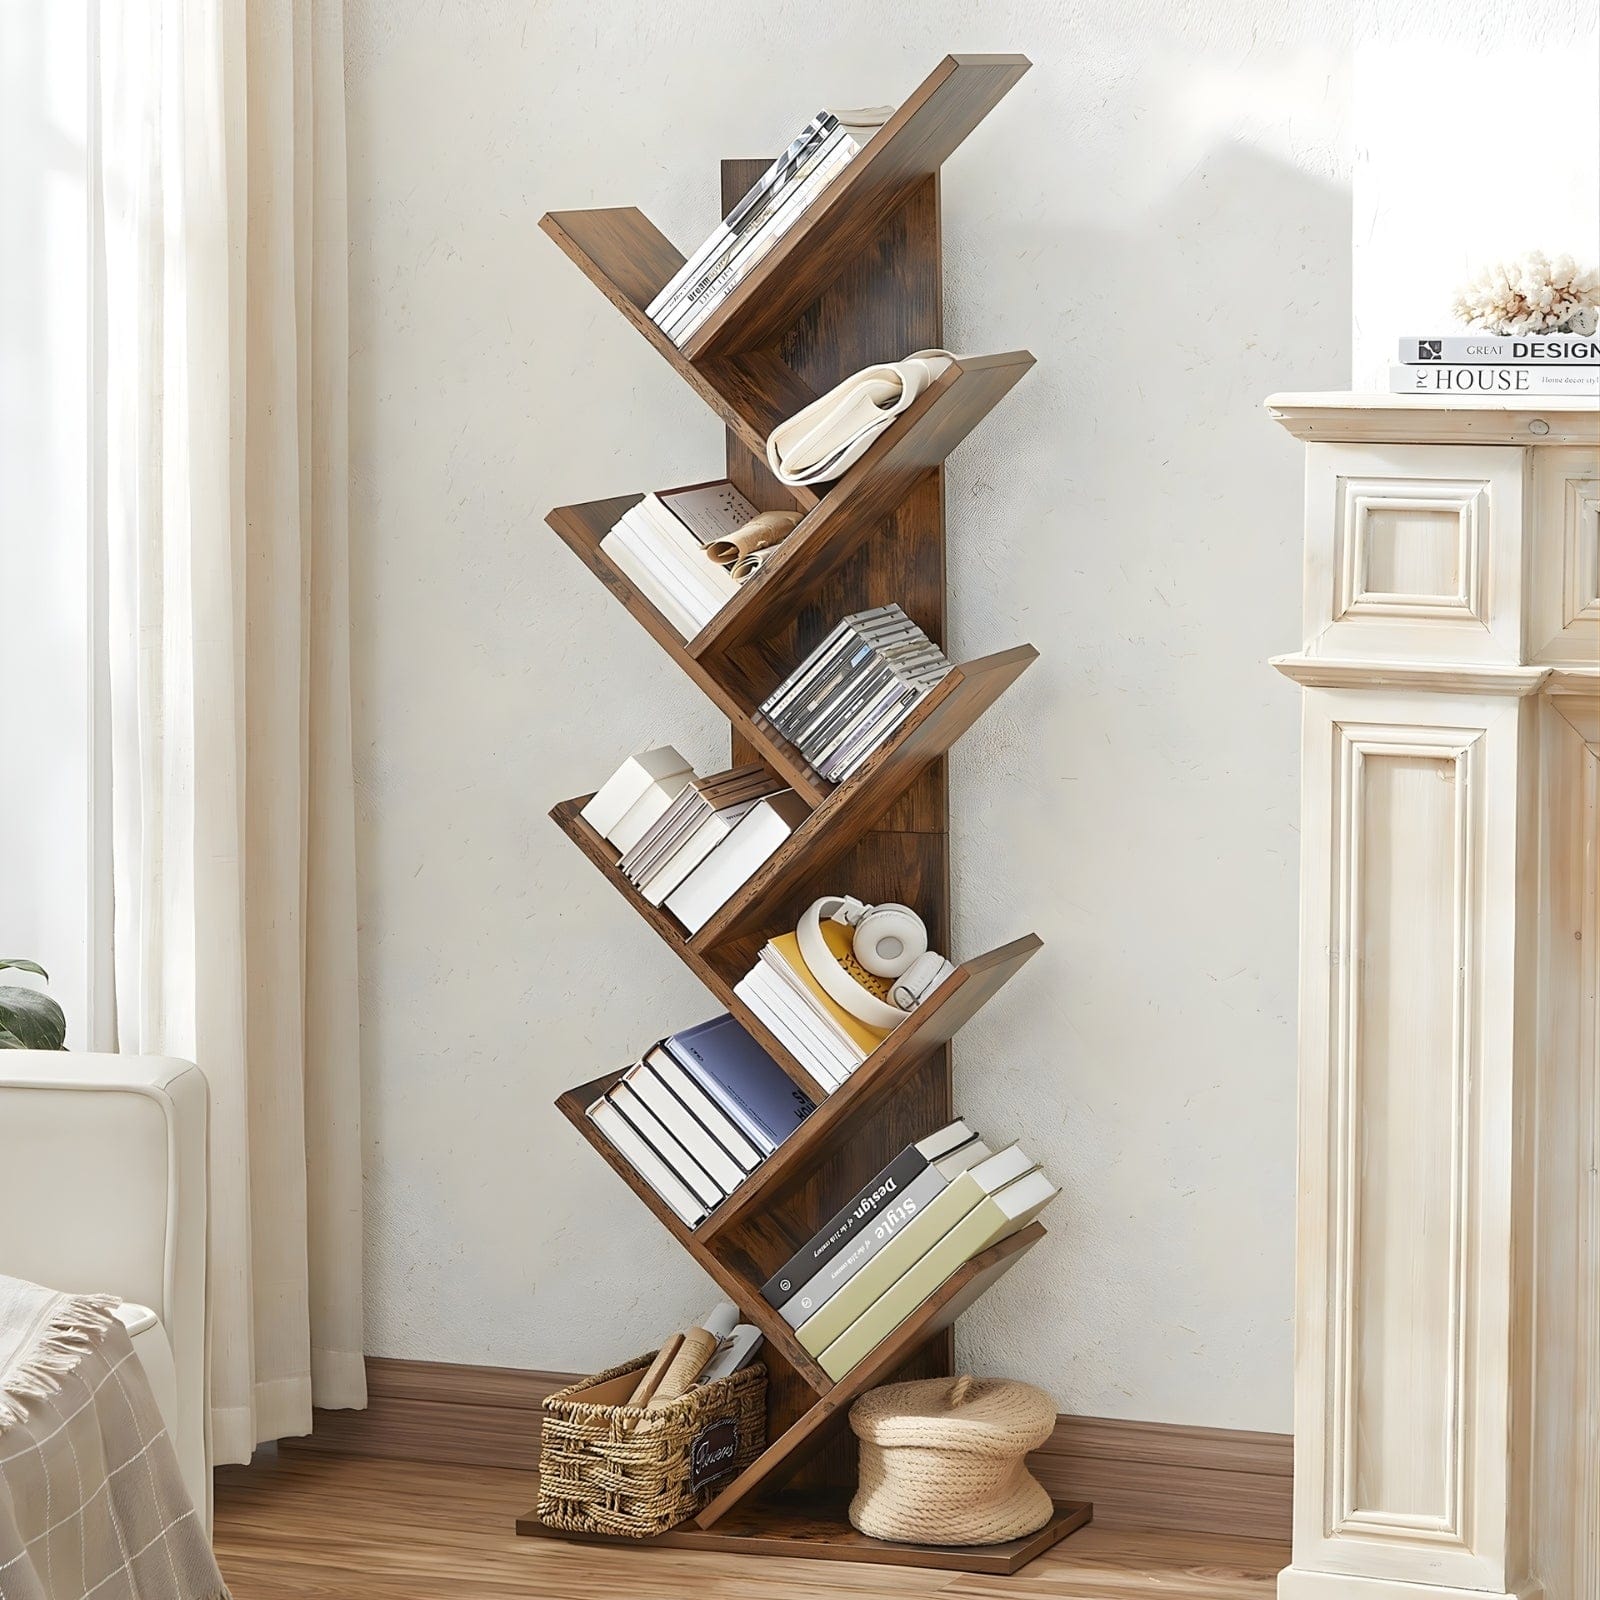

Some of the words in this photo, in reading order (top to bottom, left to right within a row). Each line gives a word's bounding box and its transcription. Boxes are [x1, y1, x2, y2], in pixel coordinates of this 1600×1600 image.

[1466, 345, 1504, 355] GREAT
[1436, 369, 1530, 390] HOUSE
[853, 1177, 898, 1219] Design
[874, 1197, 917, 1240] Style
